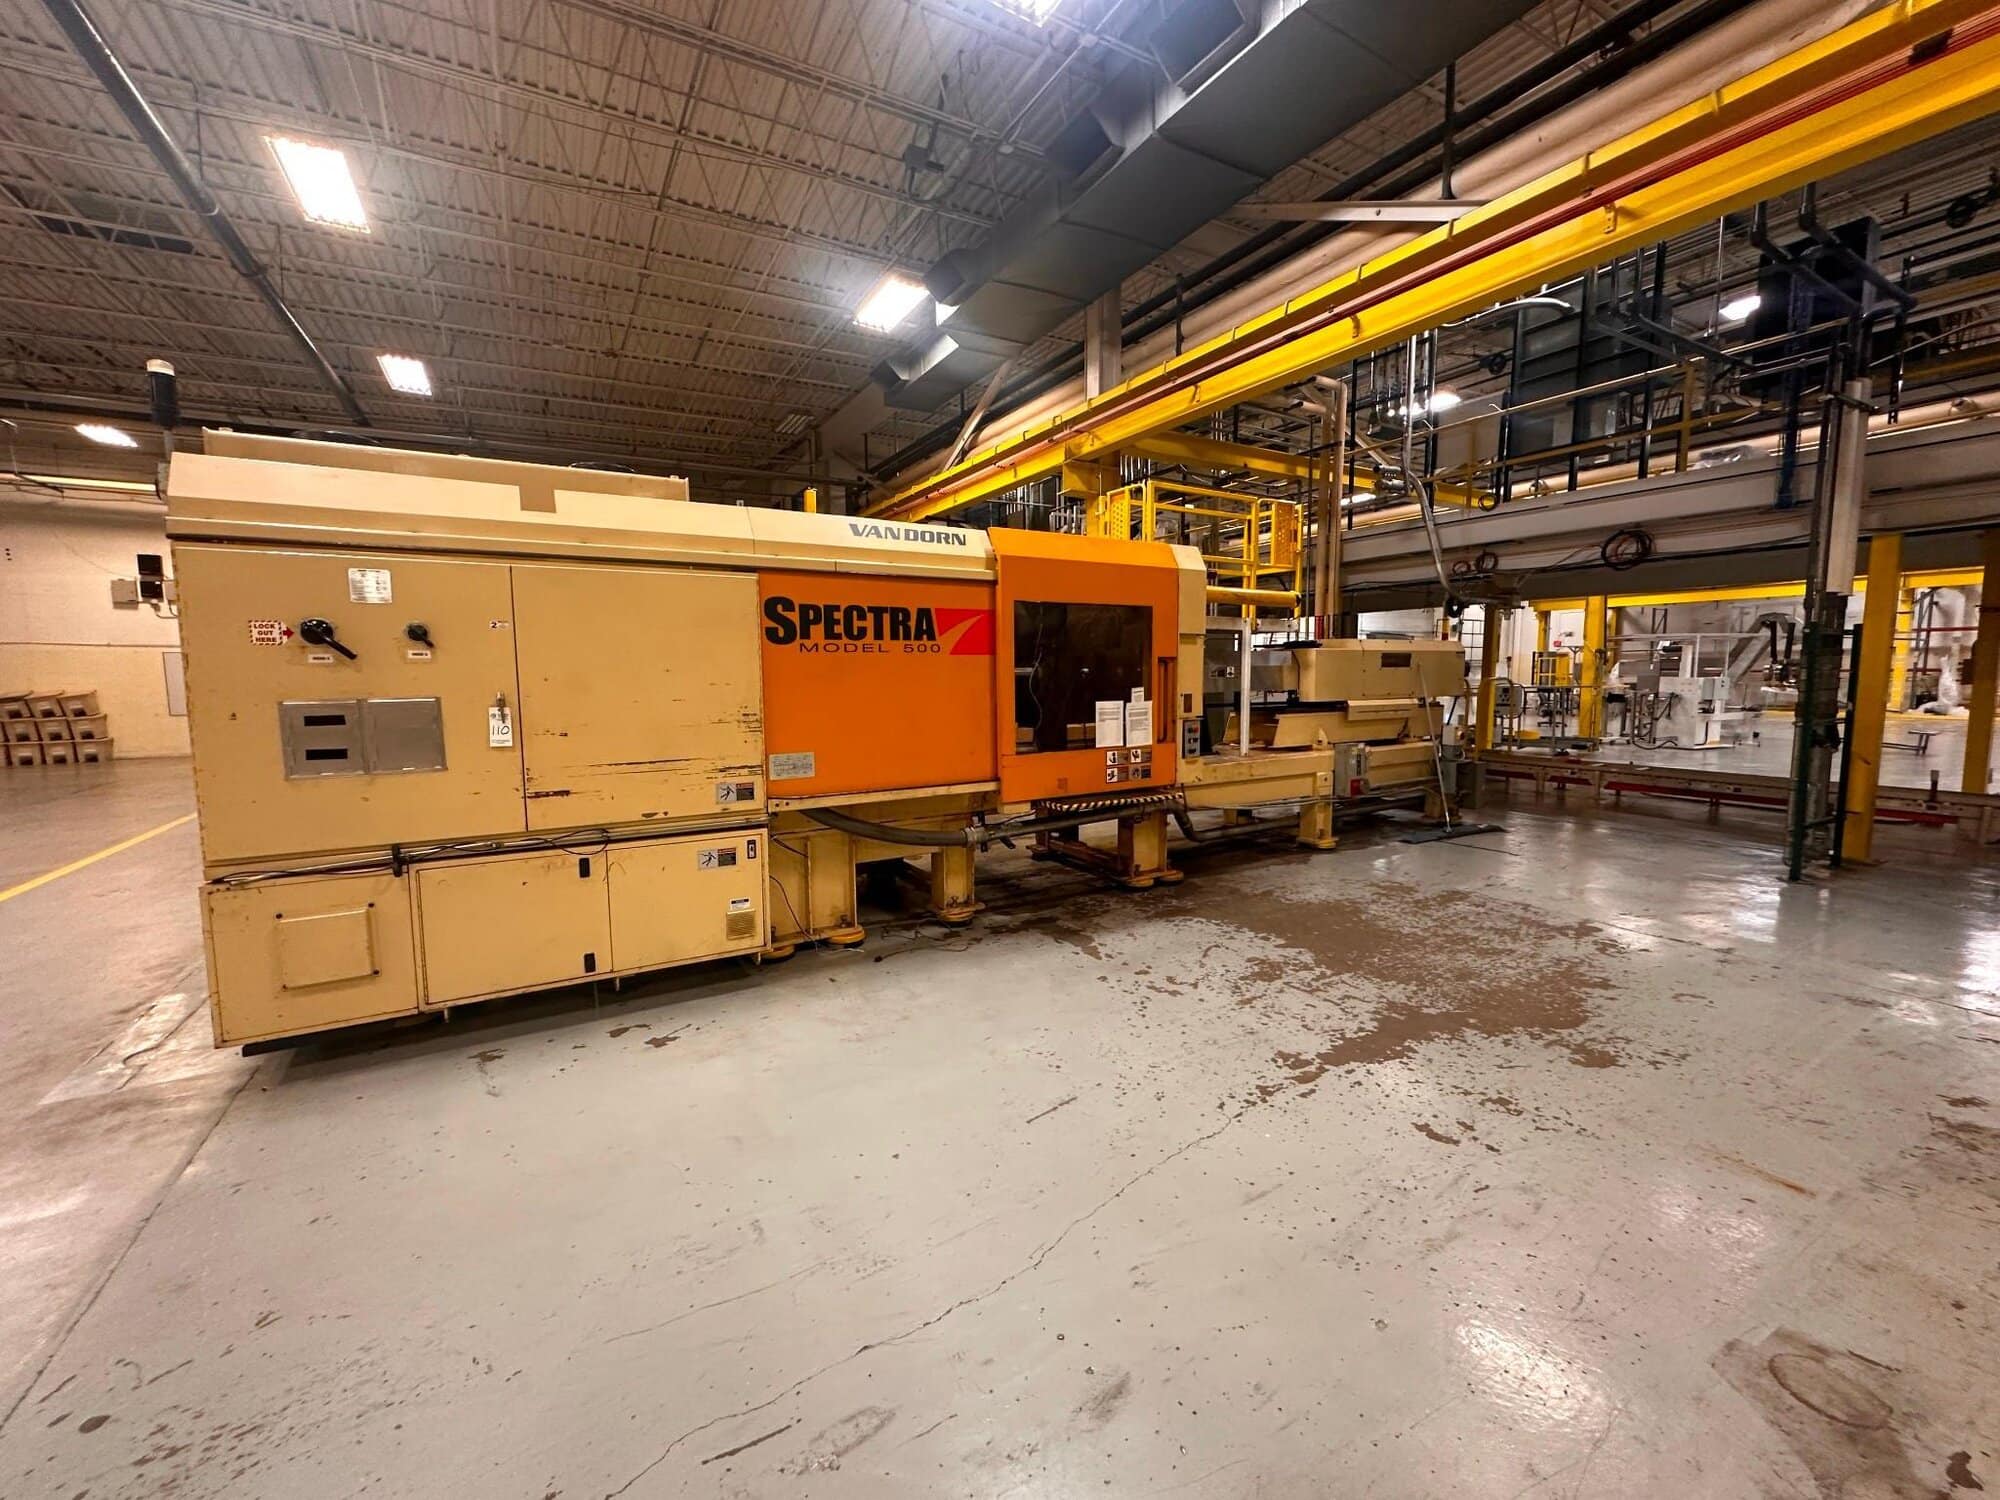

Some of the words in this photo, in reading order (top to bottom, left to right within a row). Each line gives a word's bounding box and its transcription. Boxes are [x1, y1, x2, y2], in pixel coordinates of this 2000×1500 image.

[763, 596, 937, 645] SPECTRA
[800, 642, 889, 653] MODEL
[903, 643, 942, 653] 500
[492, 725, 510, 736] 110
